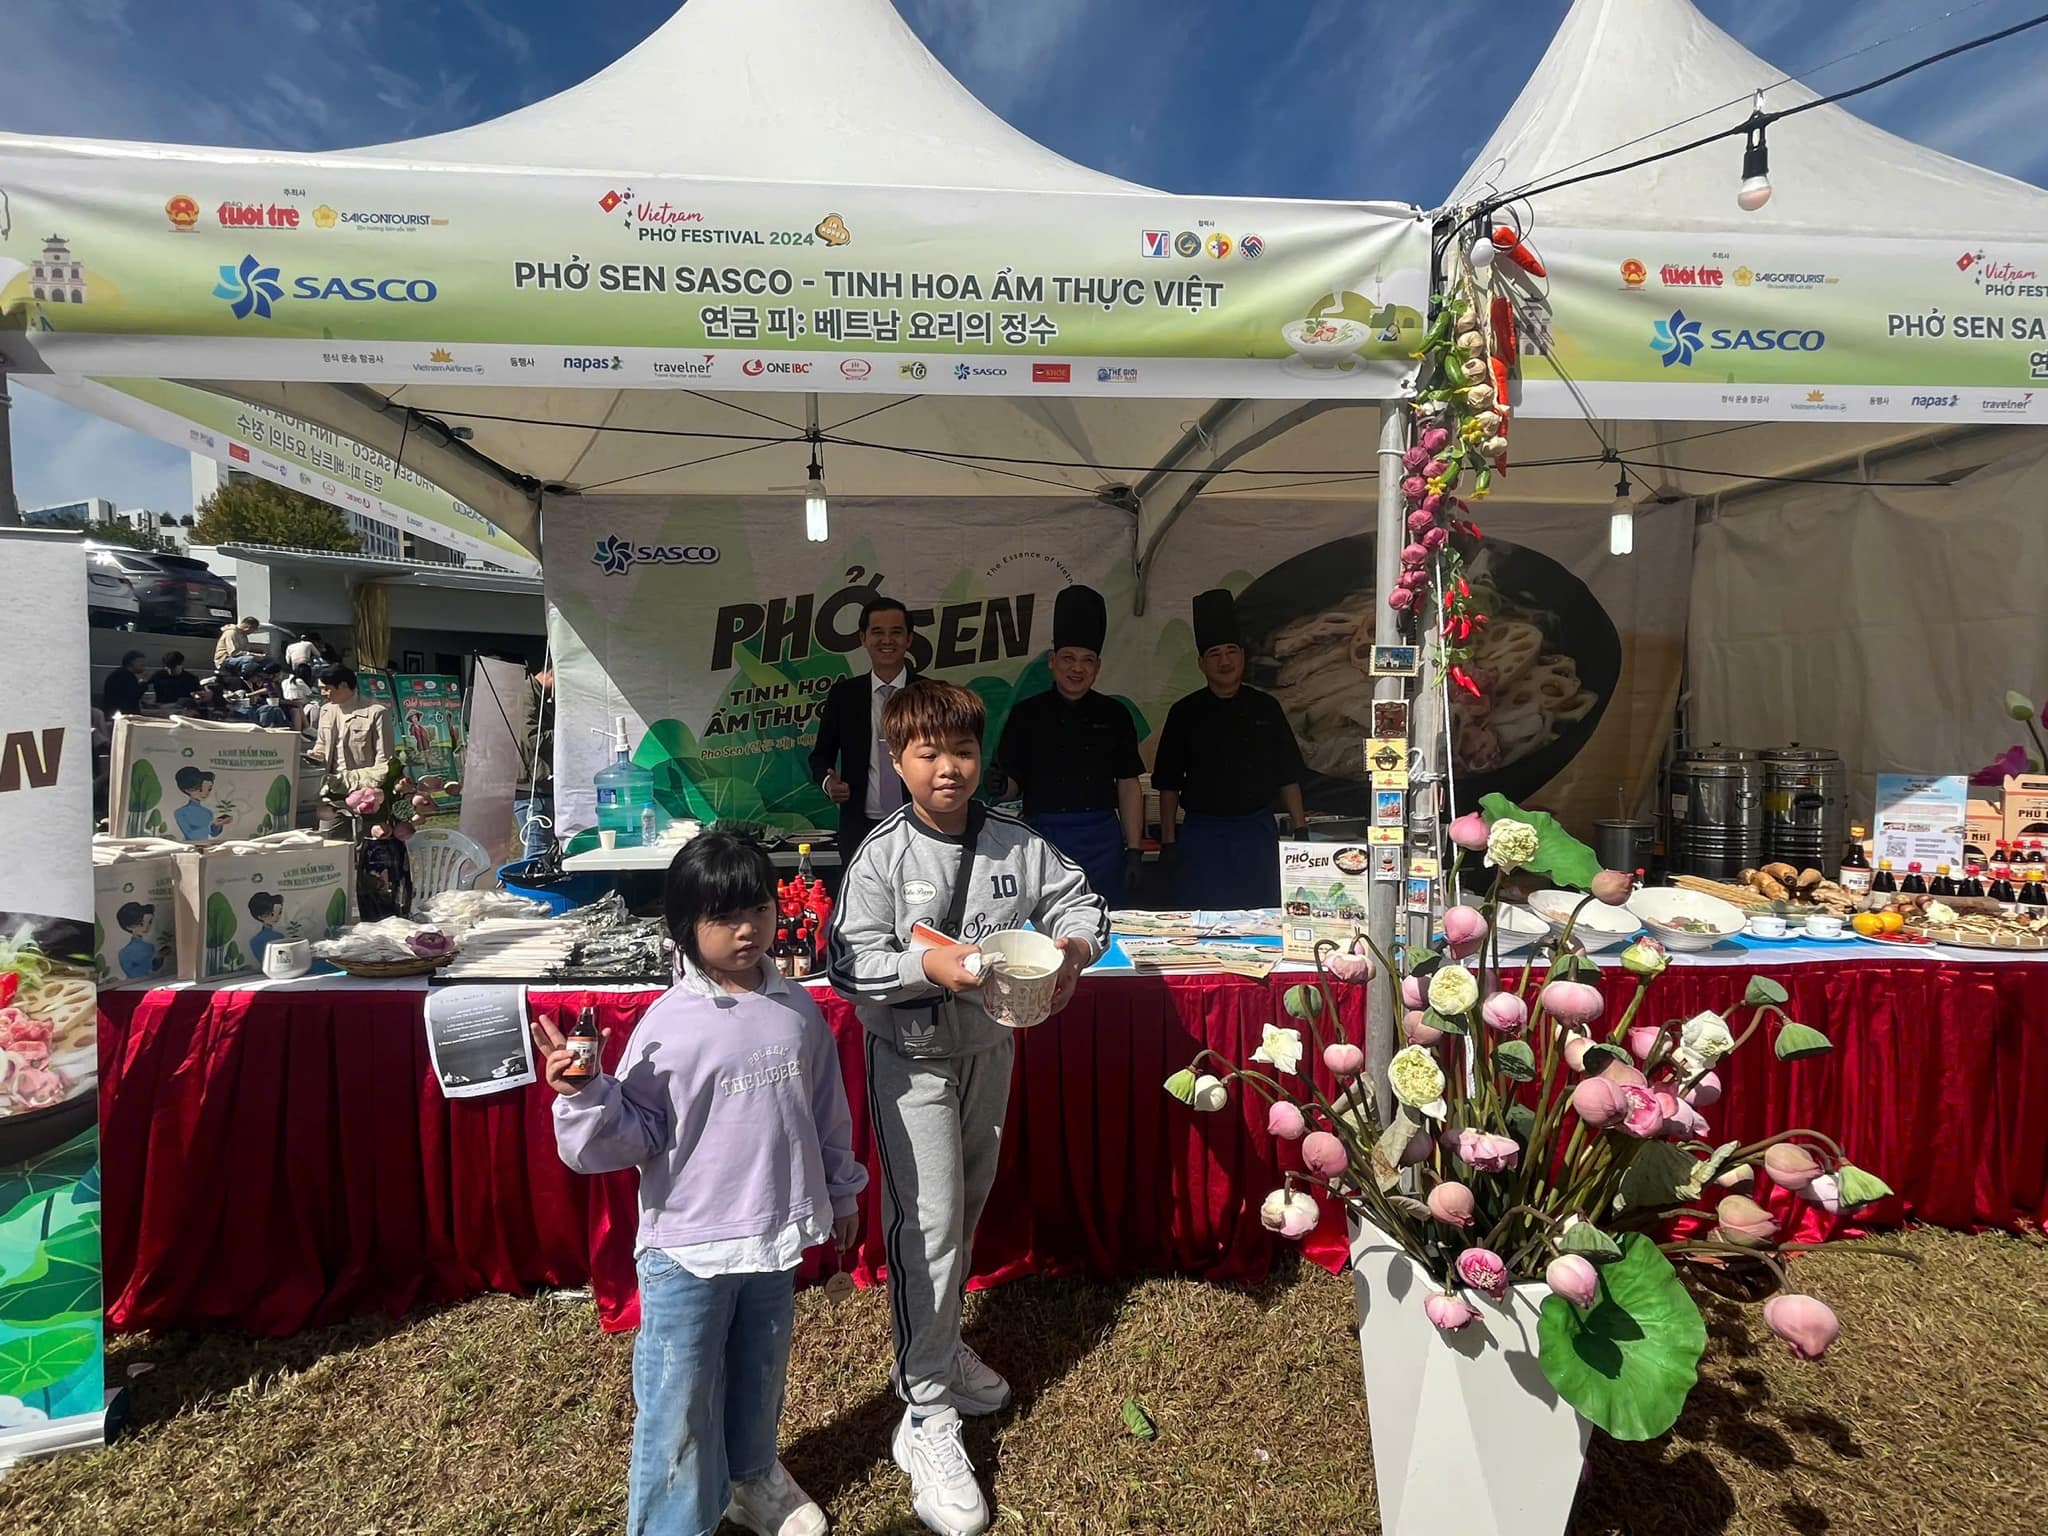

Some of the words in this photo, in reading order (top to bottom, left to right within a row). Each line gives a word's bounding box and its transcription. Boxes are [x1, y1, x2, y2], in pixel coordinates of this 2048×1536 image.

[340, 212, 431, 226] SAIGONTOURIST
[637, 202, 704, 225] Vietnam
[681, 229, 765, 245] FESTIVAL
[769, 231, 815, 246] 2024
[1754, 272, 1826, 284] SAIGONTOURIST
[1985, 261, 2038, 281] Vietnam
[293, 276, 438, 303] SASCO
[514, 254, 591, 290] PHỞ
[599, 264, 667, 293] SEN
[675, 266, 794, 296] SASCO
[824, 270, 903, 299] TINH
[911, 273, 984, 300] HOA
[990, 266, 1044, 303] ẨM
[1052, 276, 1146, 311] THỰC
[1153, 274, 1225, 313] VIỆT
[700, 305, 760, 339] 연금
[767, 307, 806, 340] 피:
[813, 308, 901, 342] 베트남
[907, 311, 992, 344] 요리의
[1000, 313, 1058, 345] 정수
[1887, 307, 1947, 338] PHỞ
[1953, 315, 2004, 340] SEN
[1710, 329, 1826, 352] SASCO
[563, 356, 610, 372] napas
[653, 360, 711, 373] travelner
[766, 362, 791, 374] ONE
[972, 368, 1007, 377] SASCO
[1911, 395, 1948, 409] napas
[1982, 399, 2029, 410] travelner
[636, 545, 717, 563] SASCO
[986, 562, 1001, 578] The
[1044, 555, 1055, 563] of
[1056, 561, 1074, 585] Vietn
[710, 565, 886, 672] PHỞ
[906, 592, 1036, 674] SEN
[730, 682, 790, 707] TINH
[704, 706, 750, 738] ẨM
[700, 749, 721, 761] Pho
[722, 746, 743, 757] Sen
[1308, 856, 1330, 868] SEN
[990, 874, 1019, 900] 10
